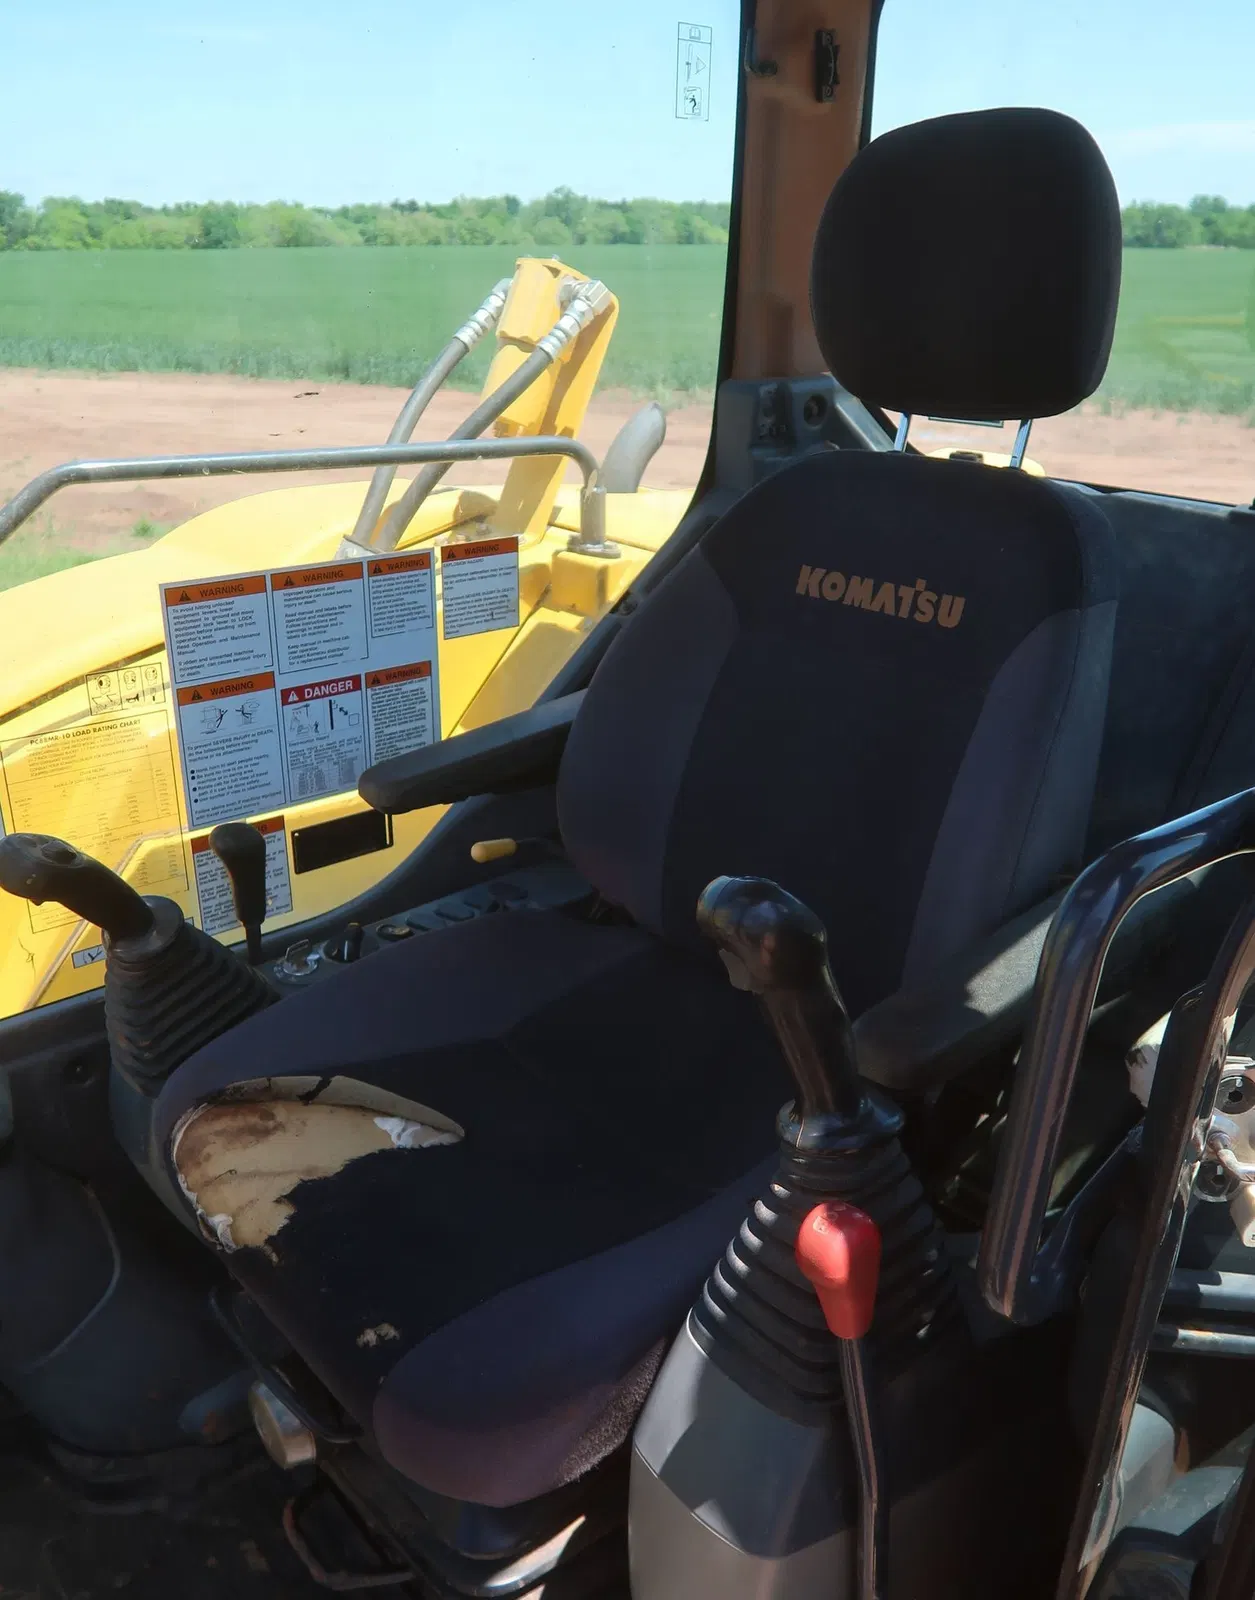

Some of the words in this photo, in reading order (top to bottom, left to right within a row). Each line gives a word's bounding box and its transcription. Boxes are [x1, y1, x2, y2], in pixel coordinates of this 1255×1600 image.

[464, 544, 500, 555] WARNING
[387, 559, 424, 571] WARNING
[303, 570, 344, 583] WARNING
[200, 584, 244, 597] WARNING
[796, 564, 966, 628] KOMATSU
[383, 667, 421, 681] WARNING
[210, 681, 254, 696] WARNING
[305, 680, 353, 698] DANGER
[72, 728, 91, 738] LOAD
[92, 723, 118, 734] RATING
[119, 719, 141, 729] CHART
